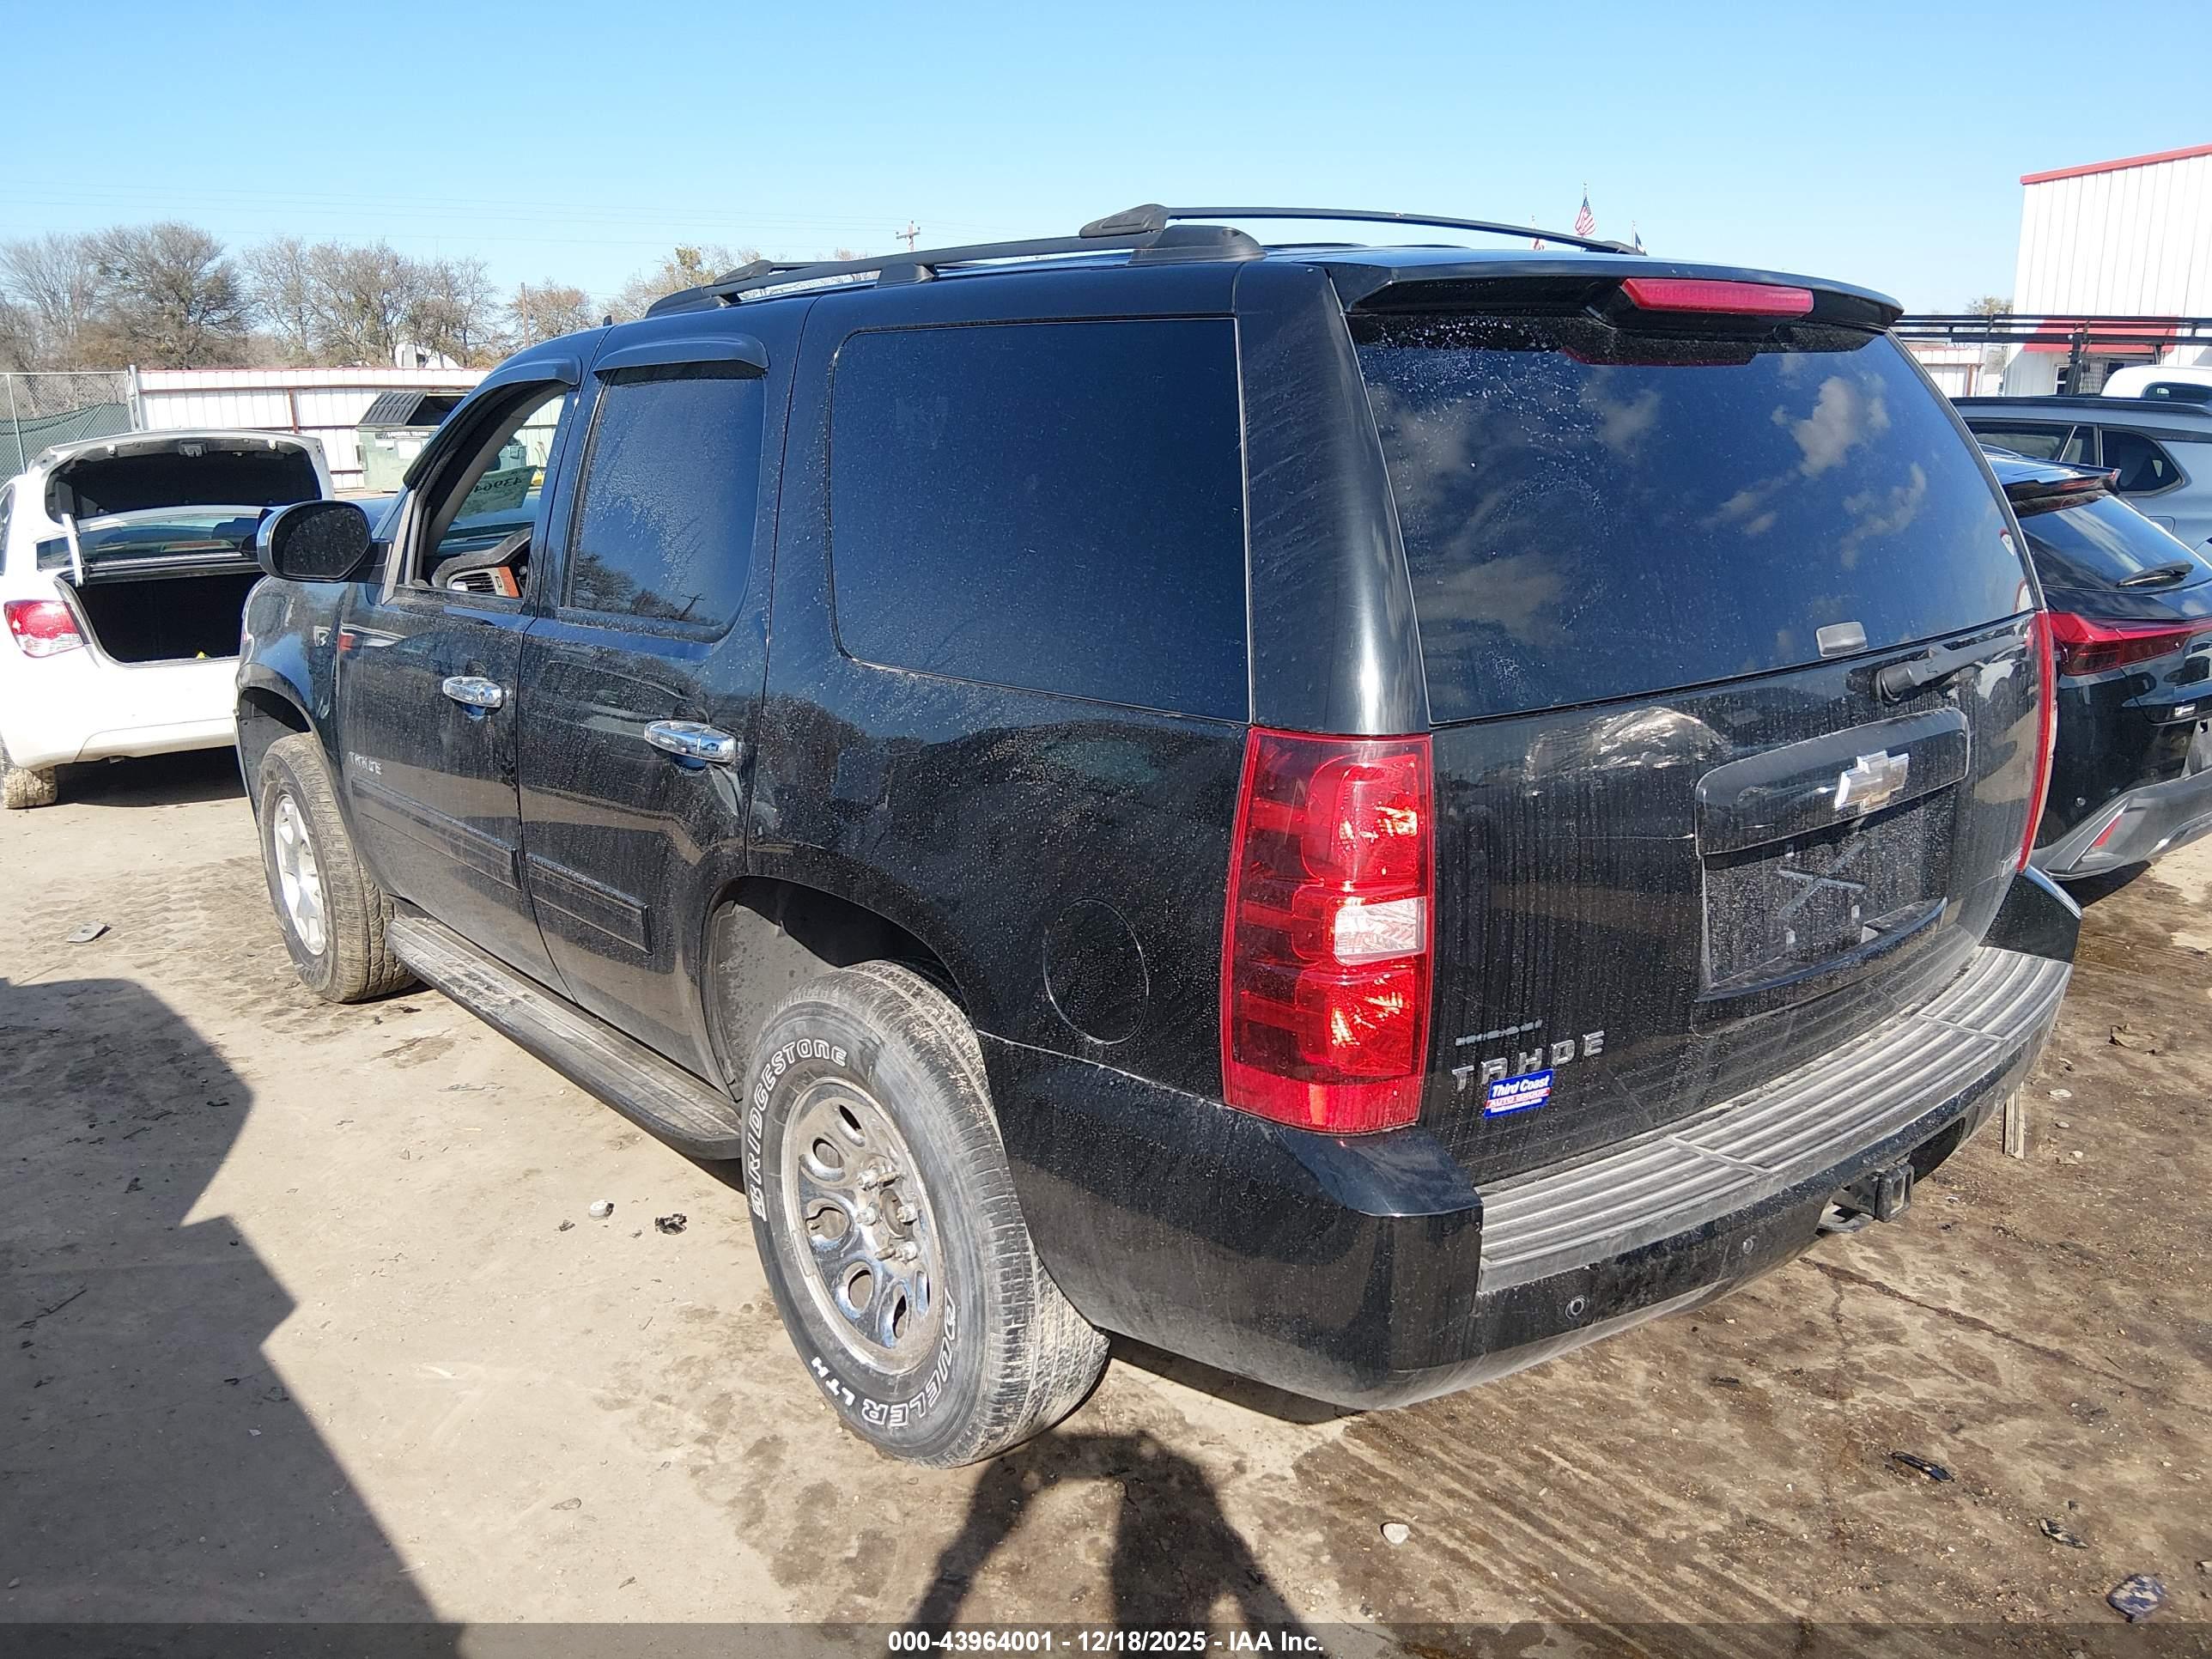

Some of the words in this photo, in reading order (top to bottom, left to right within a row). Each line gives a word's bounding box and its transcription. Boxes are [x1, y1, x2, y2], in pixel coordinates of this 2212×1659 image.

[1451, 1030, 1605, 1092] TAHOE
[1492, 1080, 1520, 1098] Third
[1519, 1074, 1550, 1092] Coast
[747, 1039, 848, 1223] BRIDGESTONE
[861, 1287, 957, 1427] DUELER
